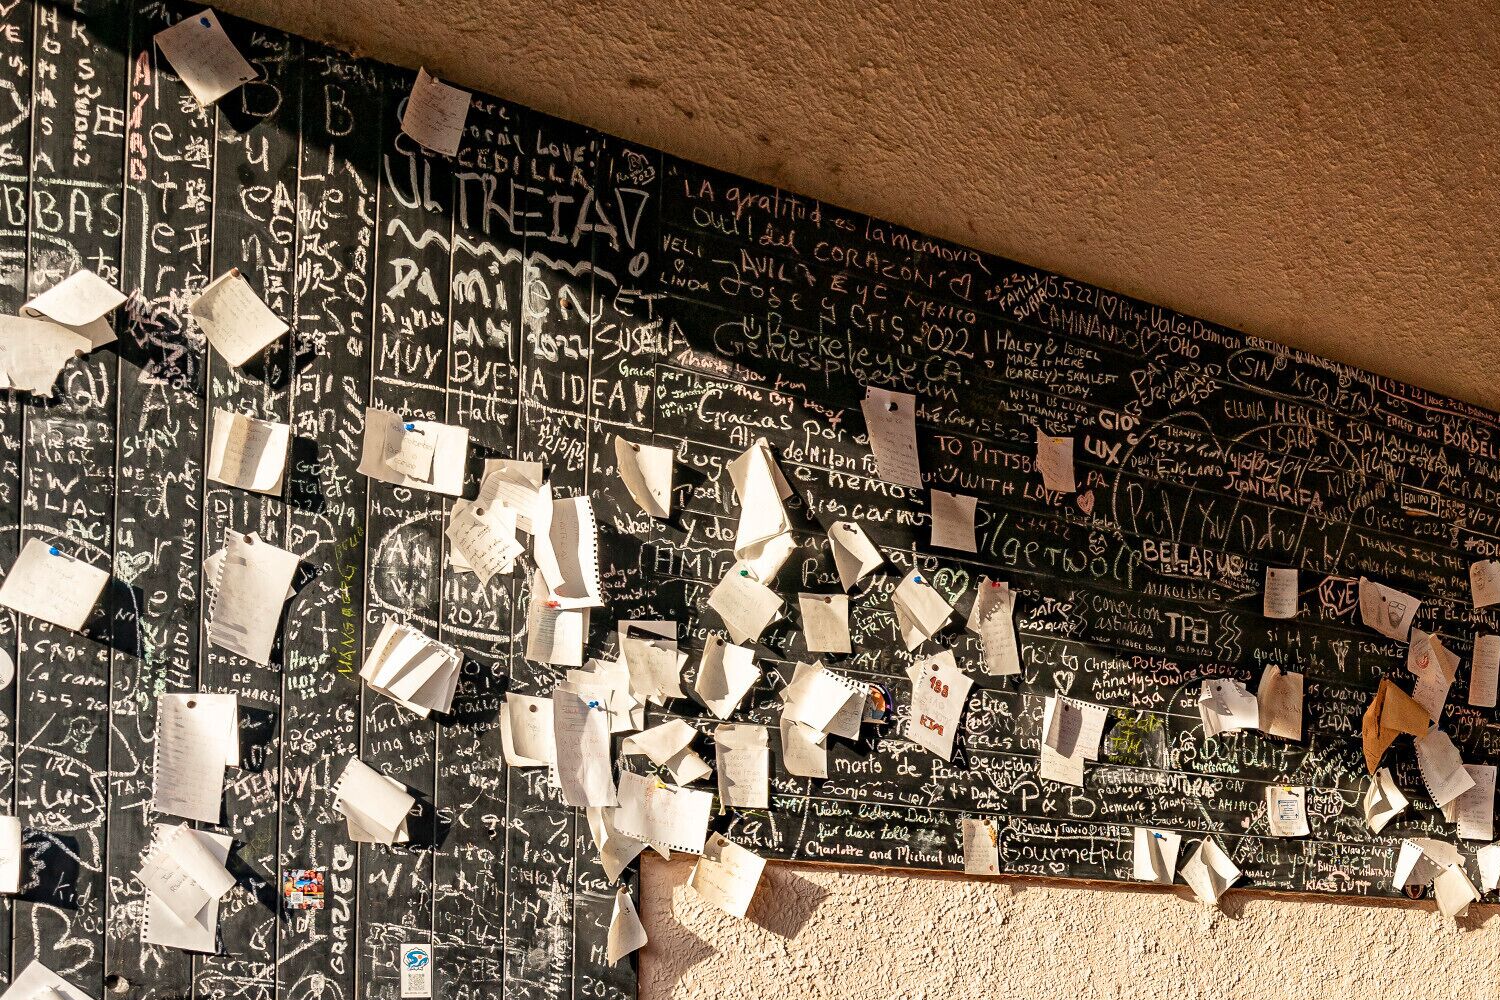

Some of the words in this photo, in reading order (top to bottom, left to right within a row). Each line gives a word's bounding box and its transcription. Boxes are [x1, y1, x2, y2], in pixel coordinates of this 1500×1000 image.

[1039, 302, 1140, 349] CAMINANDO
[379, 334, 442, 379] MUY
[698, 389, 792, 431] Gracias
[935, 435, 963, 455] TO
[1023, 482, 1068, 506] LOVE
[1142, 538, 1242, 580] BELARUS
[1133, 655, 1179, 672] Polska
[835, 755, 882, 774] morts
[897, 757, 922, 777] de
[822, 780, 868, 799] Sonja
[869, 847, 892, 860] and
